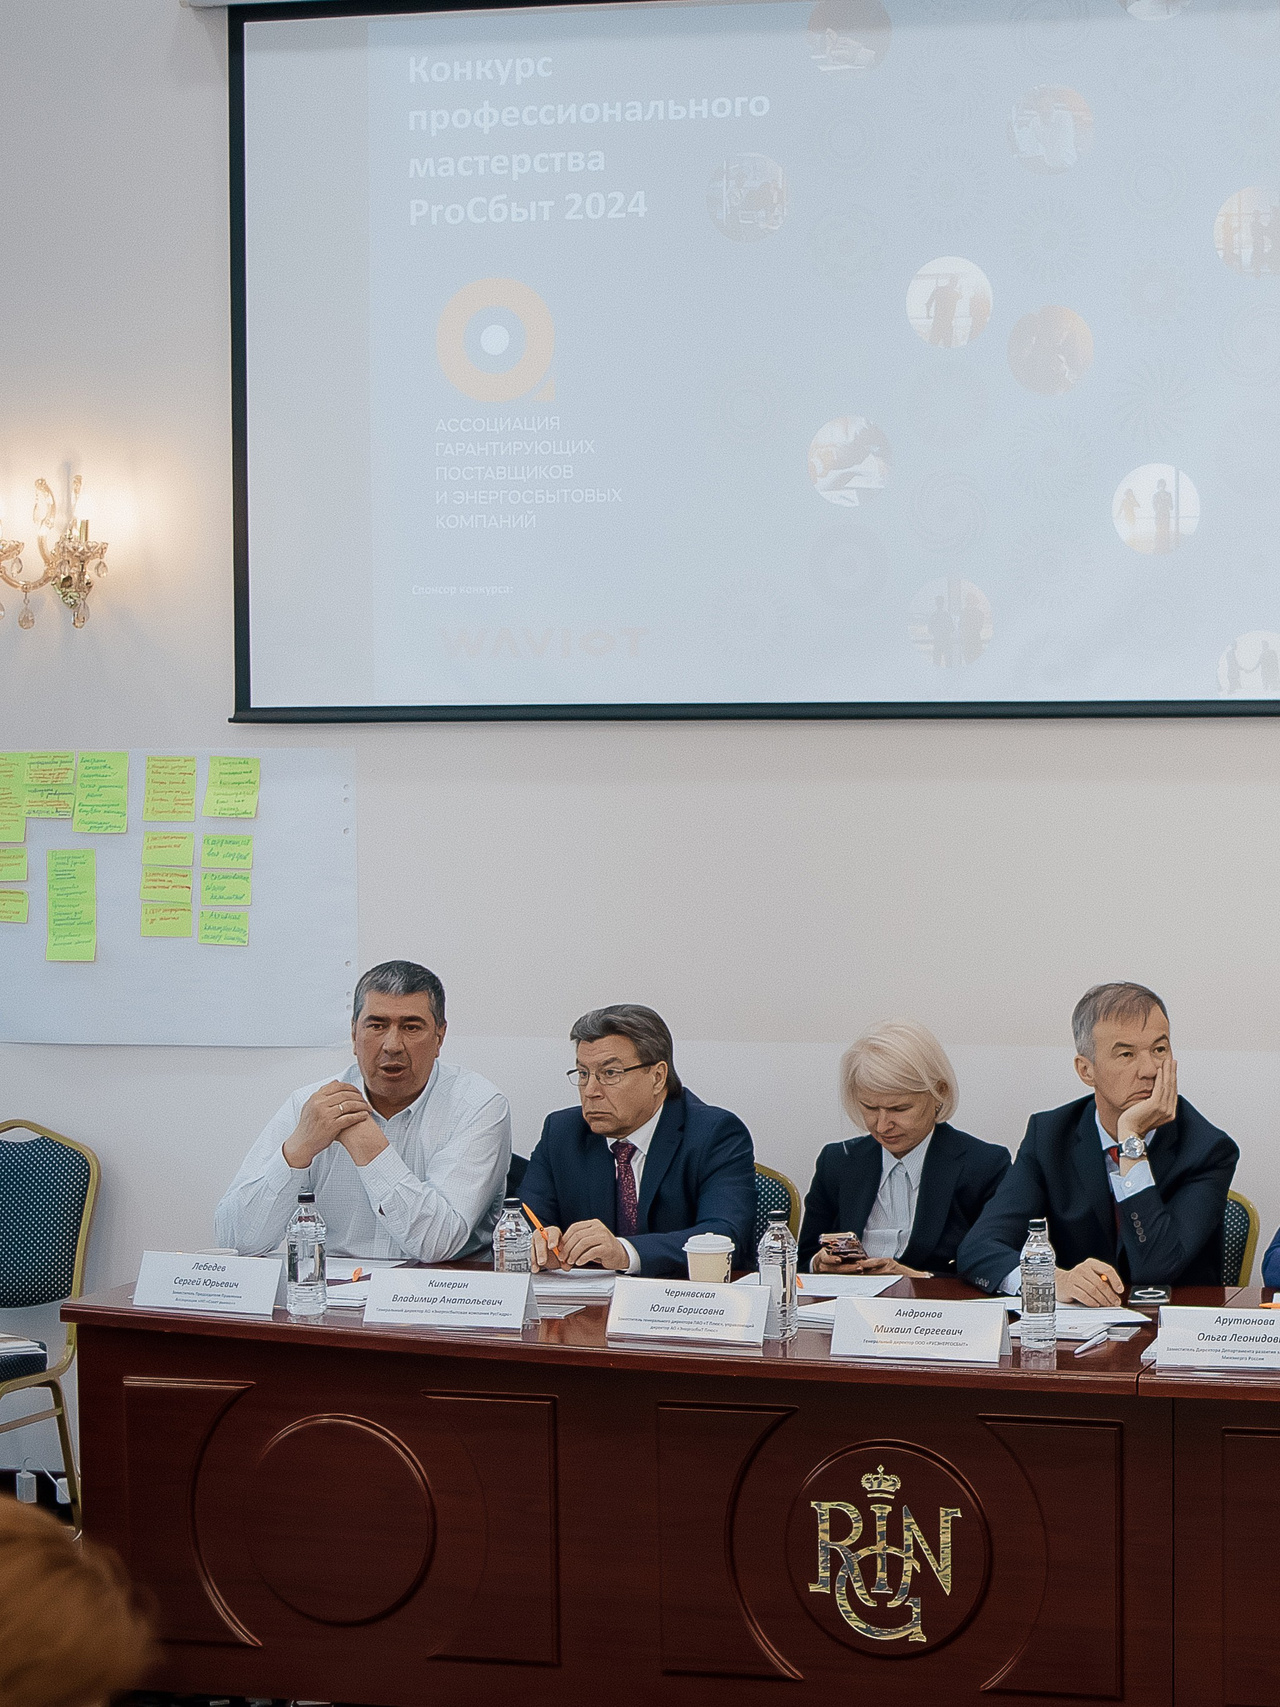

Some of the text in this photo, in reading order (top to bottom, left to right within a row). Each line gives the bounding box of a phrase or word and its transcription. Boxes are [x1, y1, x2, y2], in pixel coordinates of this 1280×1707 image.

[408, 55, 553, 86] Конкурс
[408, 95, 770, 136] профессионального
[408, 149, 605, 181] мастерства
[564, 190, 648, 222] 2024
[435, 416, 560, 434] АССОЦИАЦИЯ
[435, 439, 595, 457] ГАРАНТИРУЮЩИХ
[435, 464, 574, 482] ПОСТАВЩИКОВ
[435, 487, 622, 505] И ЭНЕРГОСБЫТОВЫХ
[435, 510, 537, 529] КОМПАНИЙ
[412, 584, 457, 596] Спонсор
[191, 1262, 227, 1272] Лебедев
[173, 1276, 239, 1289] Сергей Юрьевич
[428, 1280, 469, 1290] Кимерин
[664, 1288, 716, 1299] Чернявская
[391, 1294, 503, 1306] Владимир Анатольевич
[650, 1304, 725, 1316] Юлия Борисовна
[895, 1308, 943, 1319] Андронов
[1214, 1316, 1275, 1326] Арутюнова
[874, 1324, 963, 1336] Михаил Сергеевич
[1197, 1332, 1228, 1342] Ольга
